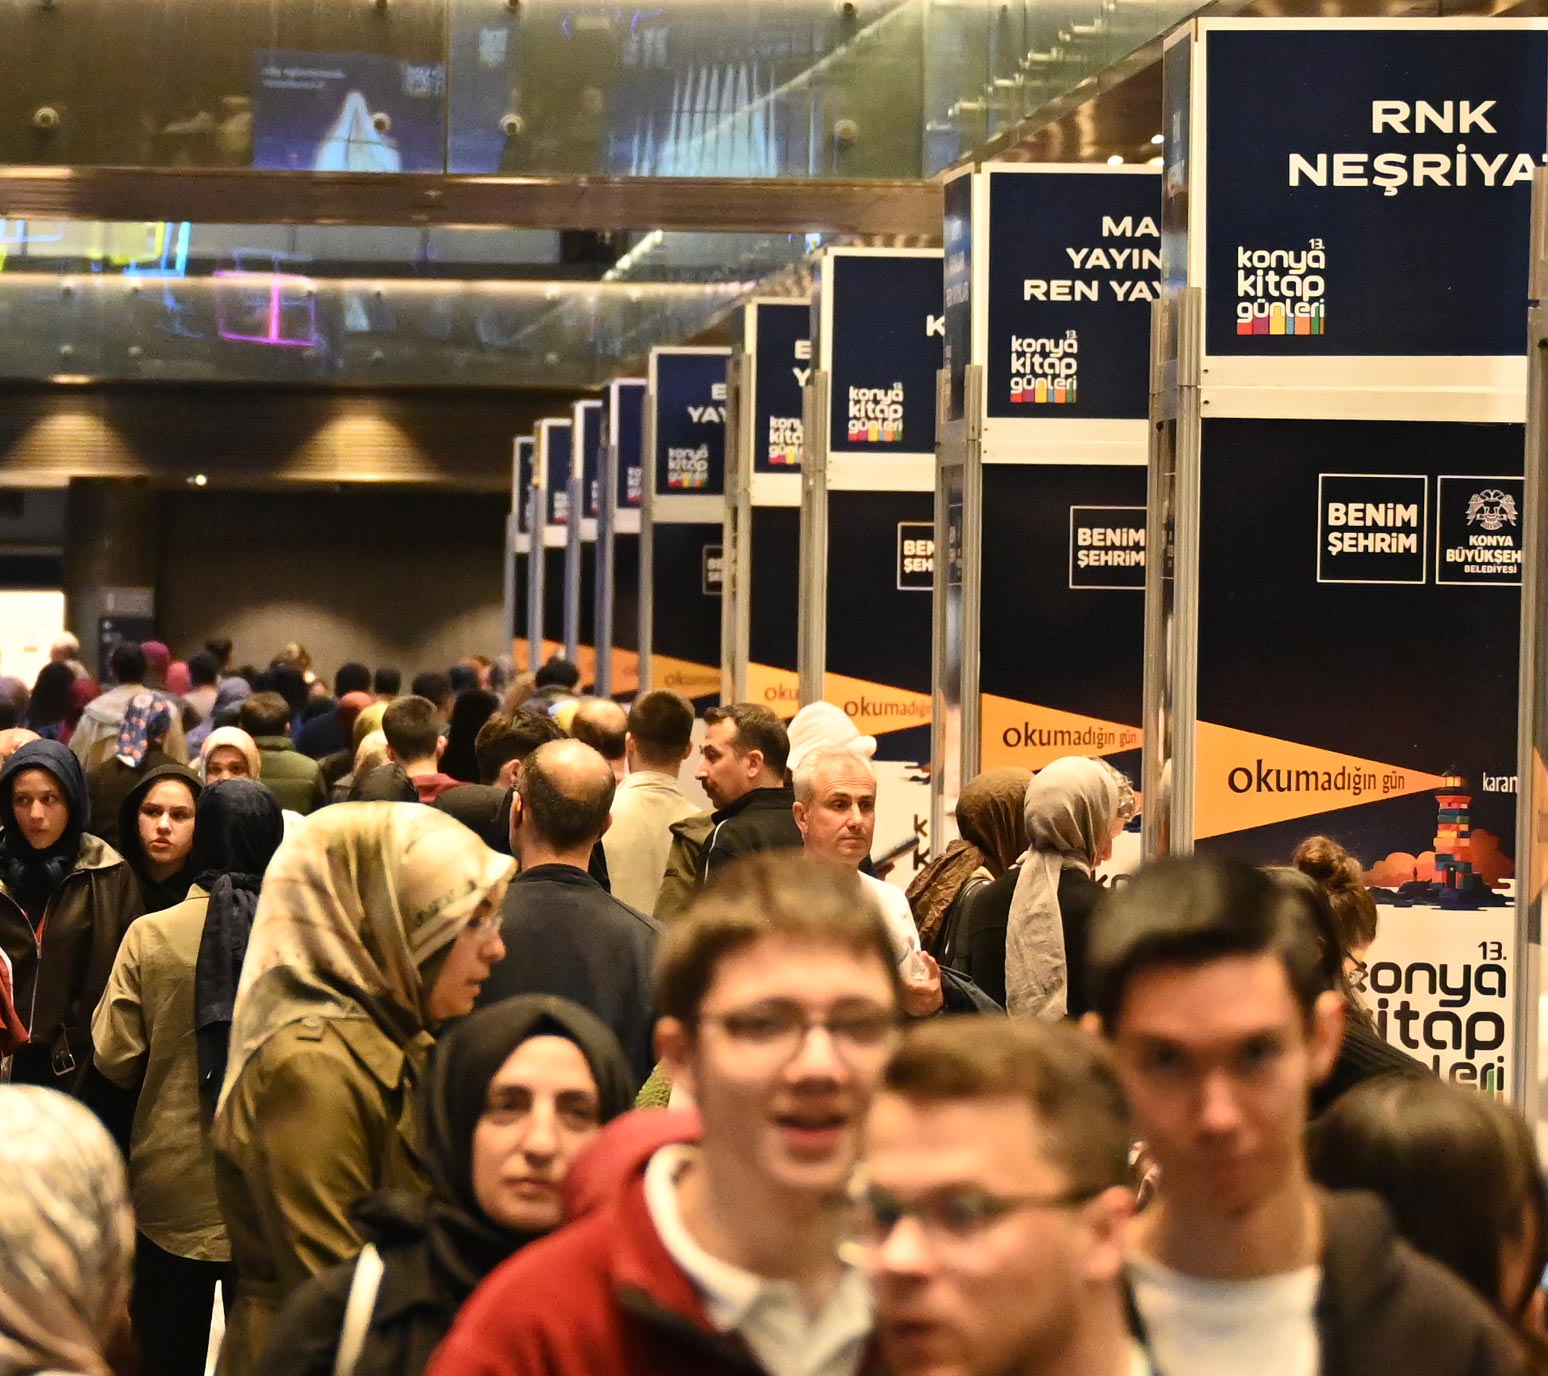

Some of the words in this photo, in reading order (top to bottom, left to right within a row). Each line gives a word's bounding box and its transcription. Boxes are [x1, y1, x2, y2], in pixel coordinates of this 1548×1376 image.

[1372, 100, 1497, 134] RNK
[1289, 145, 1548, 195] NEŞRİYA
[1237, 246, 1325, 276] konya
[1024, 279, 1098, 301] REN
[1237, 269, 1324, 303] kitap
[1237, 298, 1324, 323] günleri
[1011, 335, 1078, 357] konya
[1011, 353, 1077, 378] kitap
[849, 385, 903, 404] konya
[1010, 375, 1077, 394] günleri
[849, 400, 902, 419] kitap
[904, 540, 935, 555] BEN
[1469, 535, 1514, 547] KONYA
[1446, 544, 1522, 566] BÜYÜKŞEH
[904, 559, 934, 574] ŞEH
[1463, 562, 1517, 574] BELEDİYESİ
[1002, 721, 1116, 749] okumadığın
[1119, 730, 1137, 744] gün
[1227, 758, 1377, 802] okumadığın
[1381, 768, 1406, 794] gün
[1482, 770, 1518, 794] karan
[1478, 941, 1507, 960] 13.
[1377, 998, 1505, 1060] itap
[1432, 1054, 1504, 1091] leri
